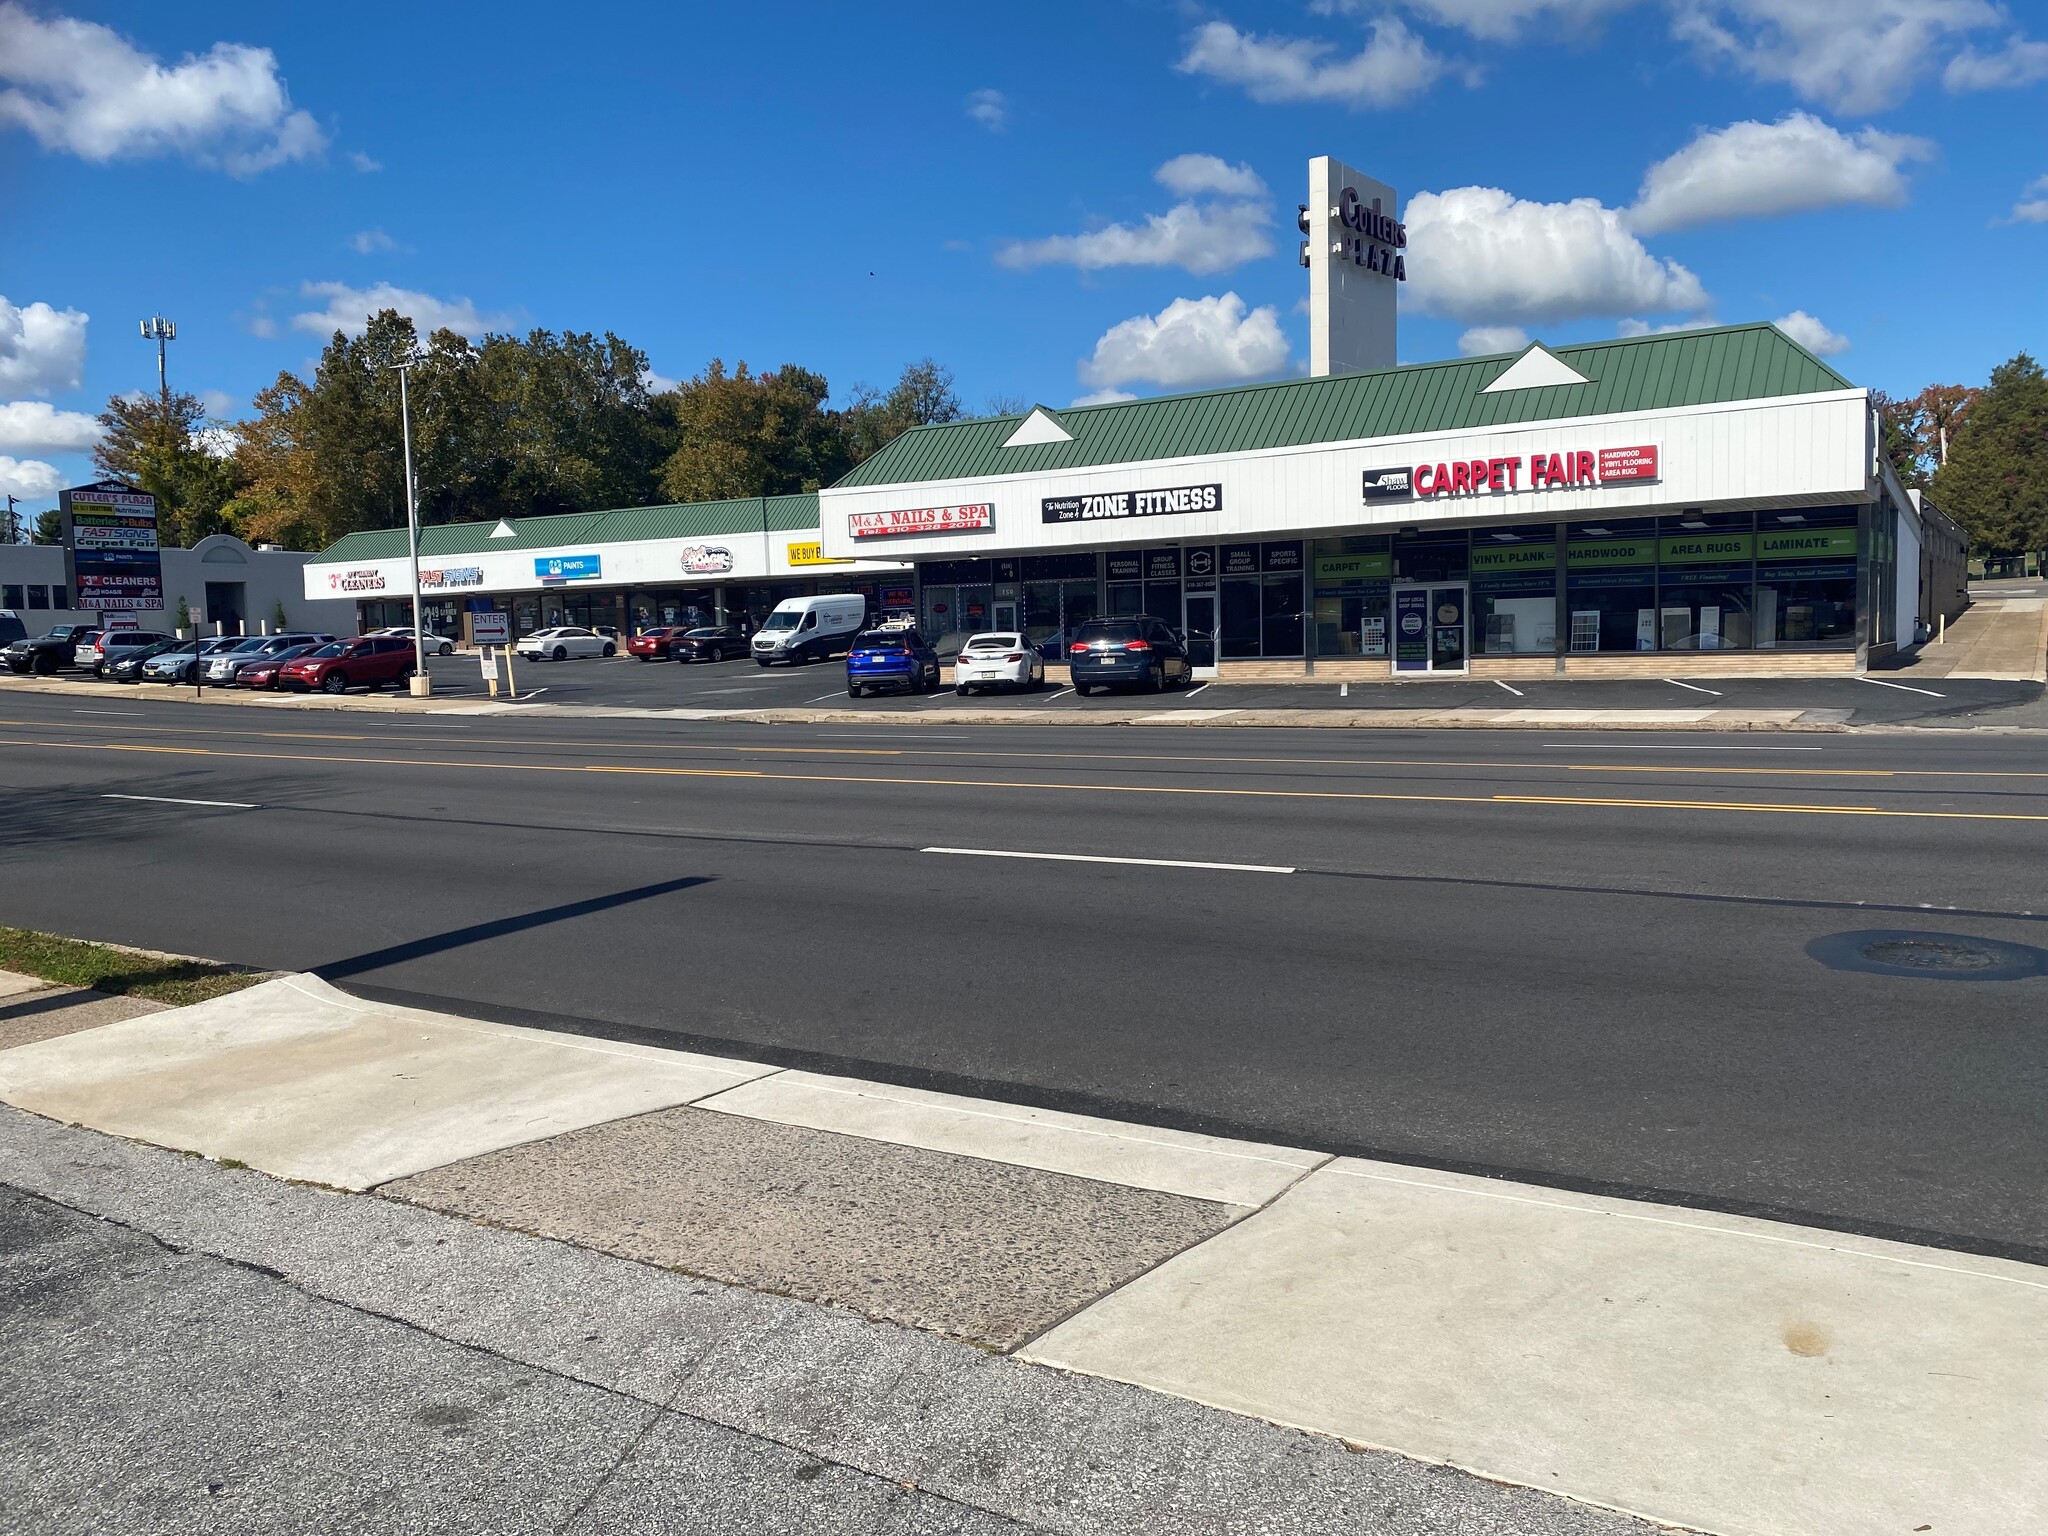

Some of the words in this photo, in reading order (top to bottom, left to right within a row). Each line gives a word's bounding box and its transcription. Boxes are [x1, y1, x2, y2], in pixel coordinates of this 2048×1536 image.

[1341, 233, 1406, 281] PLAZA
[1604, 450, 1640, 459] HARDWOOD
[1623, 458, 1653, 466] FLOORING
[1414, 456, 1520, 498] CARPET
[1531, 450, 1595, 486] FAIR
[1381, 476, 1408, 486] Shaw
[72, 493, 118, 503] CUTLER'S
[122, 495, 152, 504] PLAZA
[1082, 494, 1129, 518] ZONE
[1135, 486, 1216, 514] FITNESS
[1054, 501, 1080, 509] Nutrition
[891, 509, 935, 525] NAILS
[942, 509, 952, 521] &
[959, 505, 988, 520] SPA
[1059, 511, 1074, 519] Zone
[76, 516, 119, 526] Batteries
[129, 518, 153, 528] Bulbs
[887, 521, 976, 533] 610-328-2011
[82, 528, 150, 538] FASTSIGNS
[76, 538, 124, 547] Carpet
[1764, 538, 1829, 550] LAMINATE
[791, 548, 800, 560] WE
[802, 547, 814, 559] BUY
[1569, 548, 1635, 559] HARDWOOD
[1671, 545, 1702, 555] AREA
[1707, 543, 1741, 553] RUGS
[1474, 554, 1505, 564] VINYL
[1509, 552, 1545, 562] PLANK
[563, 561, 584, 570] PAINTS
[1322, 563, 1360, 572] CARPET
[102, 577, 156, 586] CLEANERS
[342, 577, 386, 590] CLEANERS
[104, 599, 133, 608] NAILS
[136, 599, 141, 608] &
[145, 599, 162, 608] SPA
[474, 615, 506, 624] ENTER
